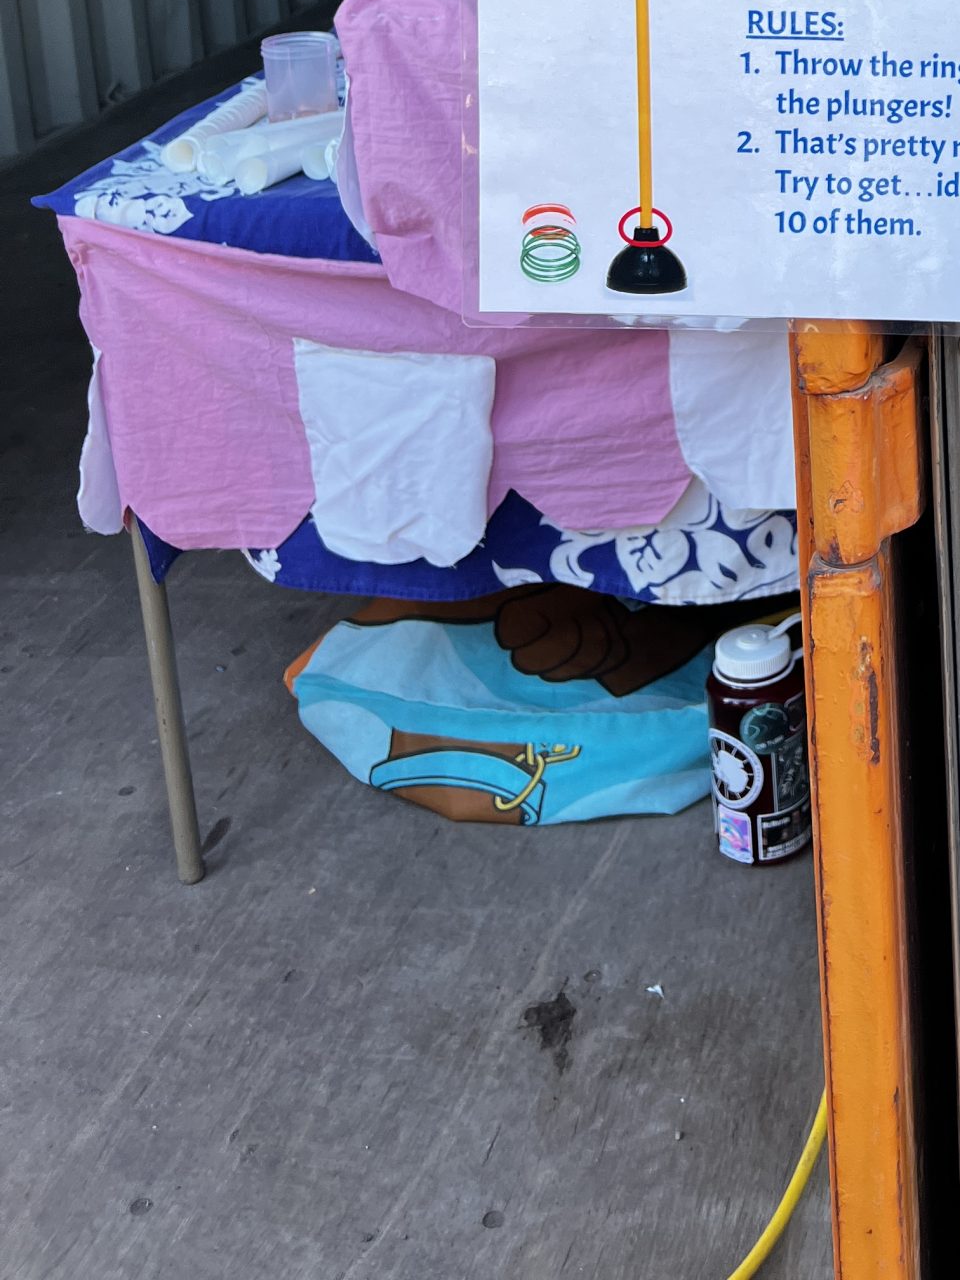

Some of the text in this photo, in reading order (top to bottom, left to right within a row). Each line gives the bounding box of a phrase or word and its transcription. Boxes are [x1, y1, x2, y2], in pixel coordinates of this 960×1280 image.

[747, 9, 845, 39] RULES:
[740, 51, 760, 74] 1.
[775, 49, 863, 77] Throw
[869, 51, 914, 78] the
[776, 88, 953, 124] the plungers!
[736, 130, 761, 154] 2.
[775, 127, 857, 156] That’s
[863, 135, 947, 165] pretty
[774, 169, 819, 201] Try
[825, 173, 852, 196] to
[774, 208, 922, 236] 10 of them.
